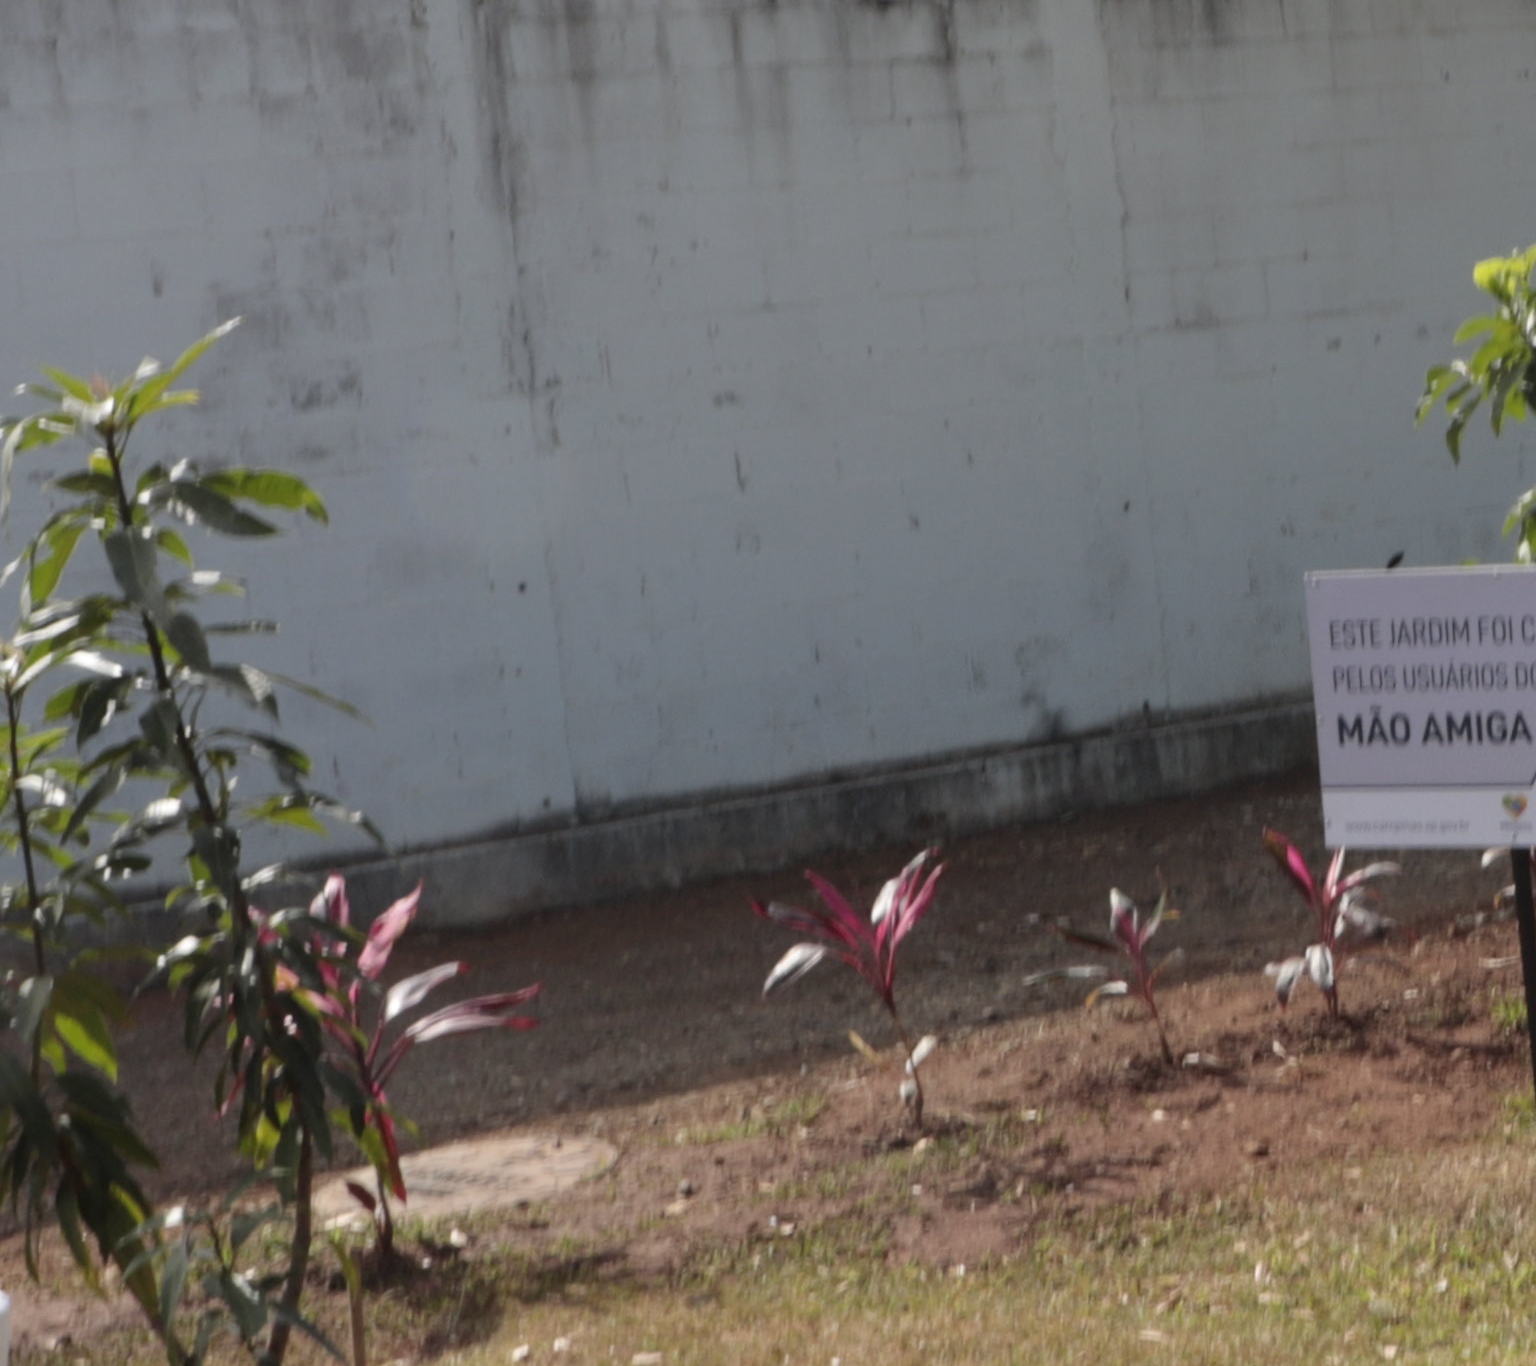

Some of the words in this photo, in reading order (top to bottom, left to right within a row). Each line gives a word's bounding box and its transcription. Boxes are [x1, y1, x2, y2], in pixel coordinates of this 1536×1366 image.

[1329, 618, 1382, 650] ESTE
[1389, 615, 1470, 649] JARDIM
[1477, 613, 1513, 648] FOI
[1332, 664, 1397, 695] PELOS
[1402, 657, 1508, 693] USUÁRIOS
[1337, 704, 1411, 748] MÃO
[1421, 710, 1533, 747] AMIGA
